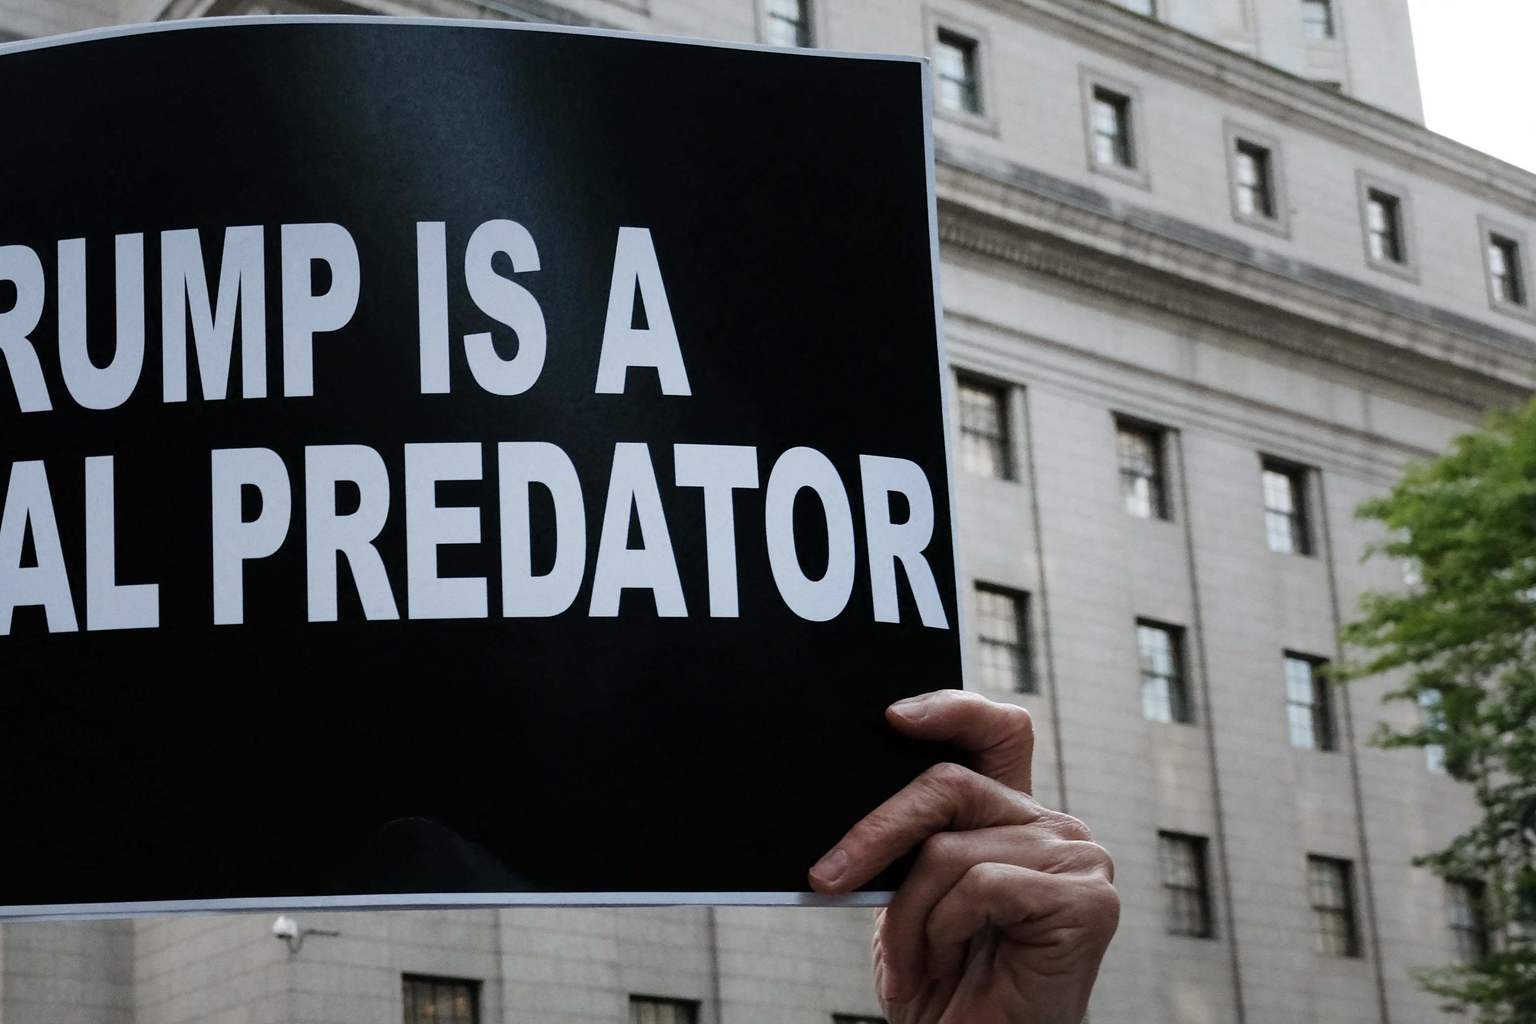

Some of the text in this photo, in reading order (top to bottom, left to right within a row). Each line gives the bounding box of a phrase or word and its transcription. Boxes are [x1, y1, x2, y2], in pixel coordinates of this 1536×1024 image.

[416, 218, 547, 396] IS
[594, 226, 692, 396] A
[211, 441, 951, 630] PREDATOR
